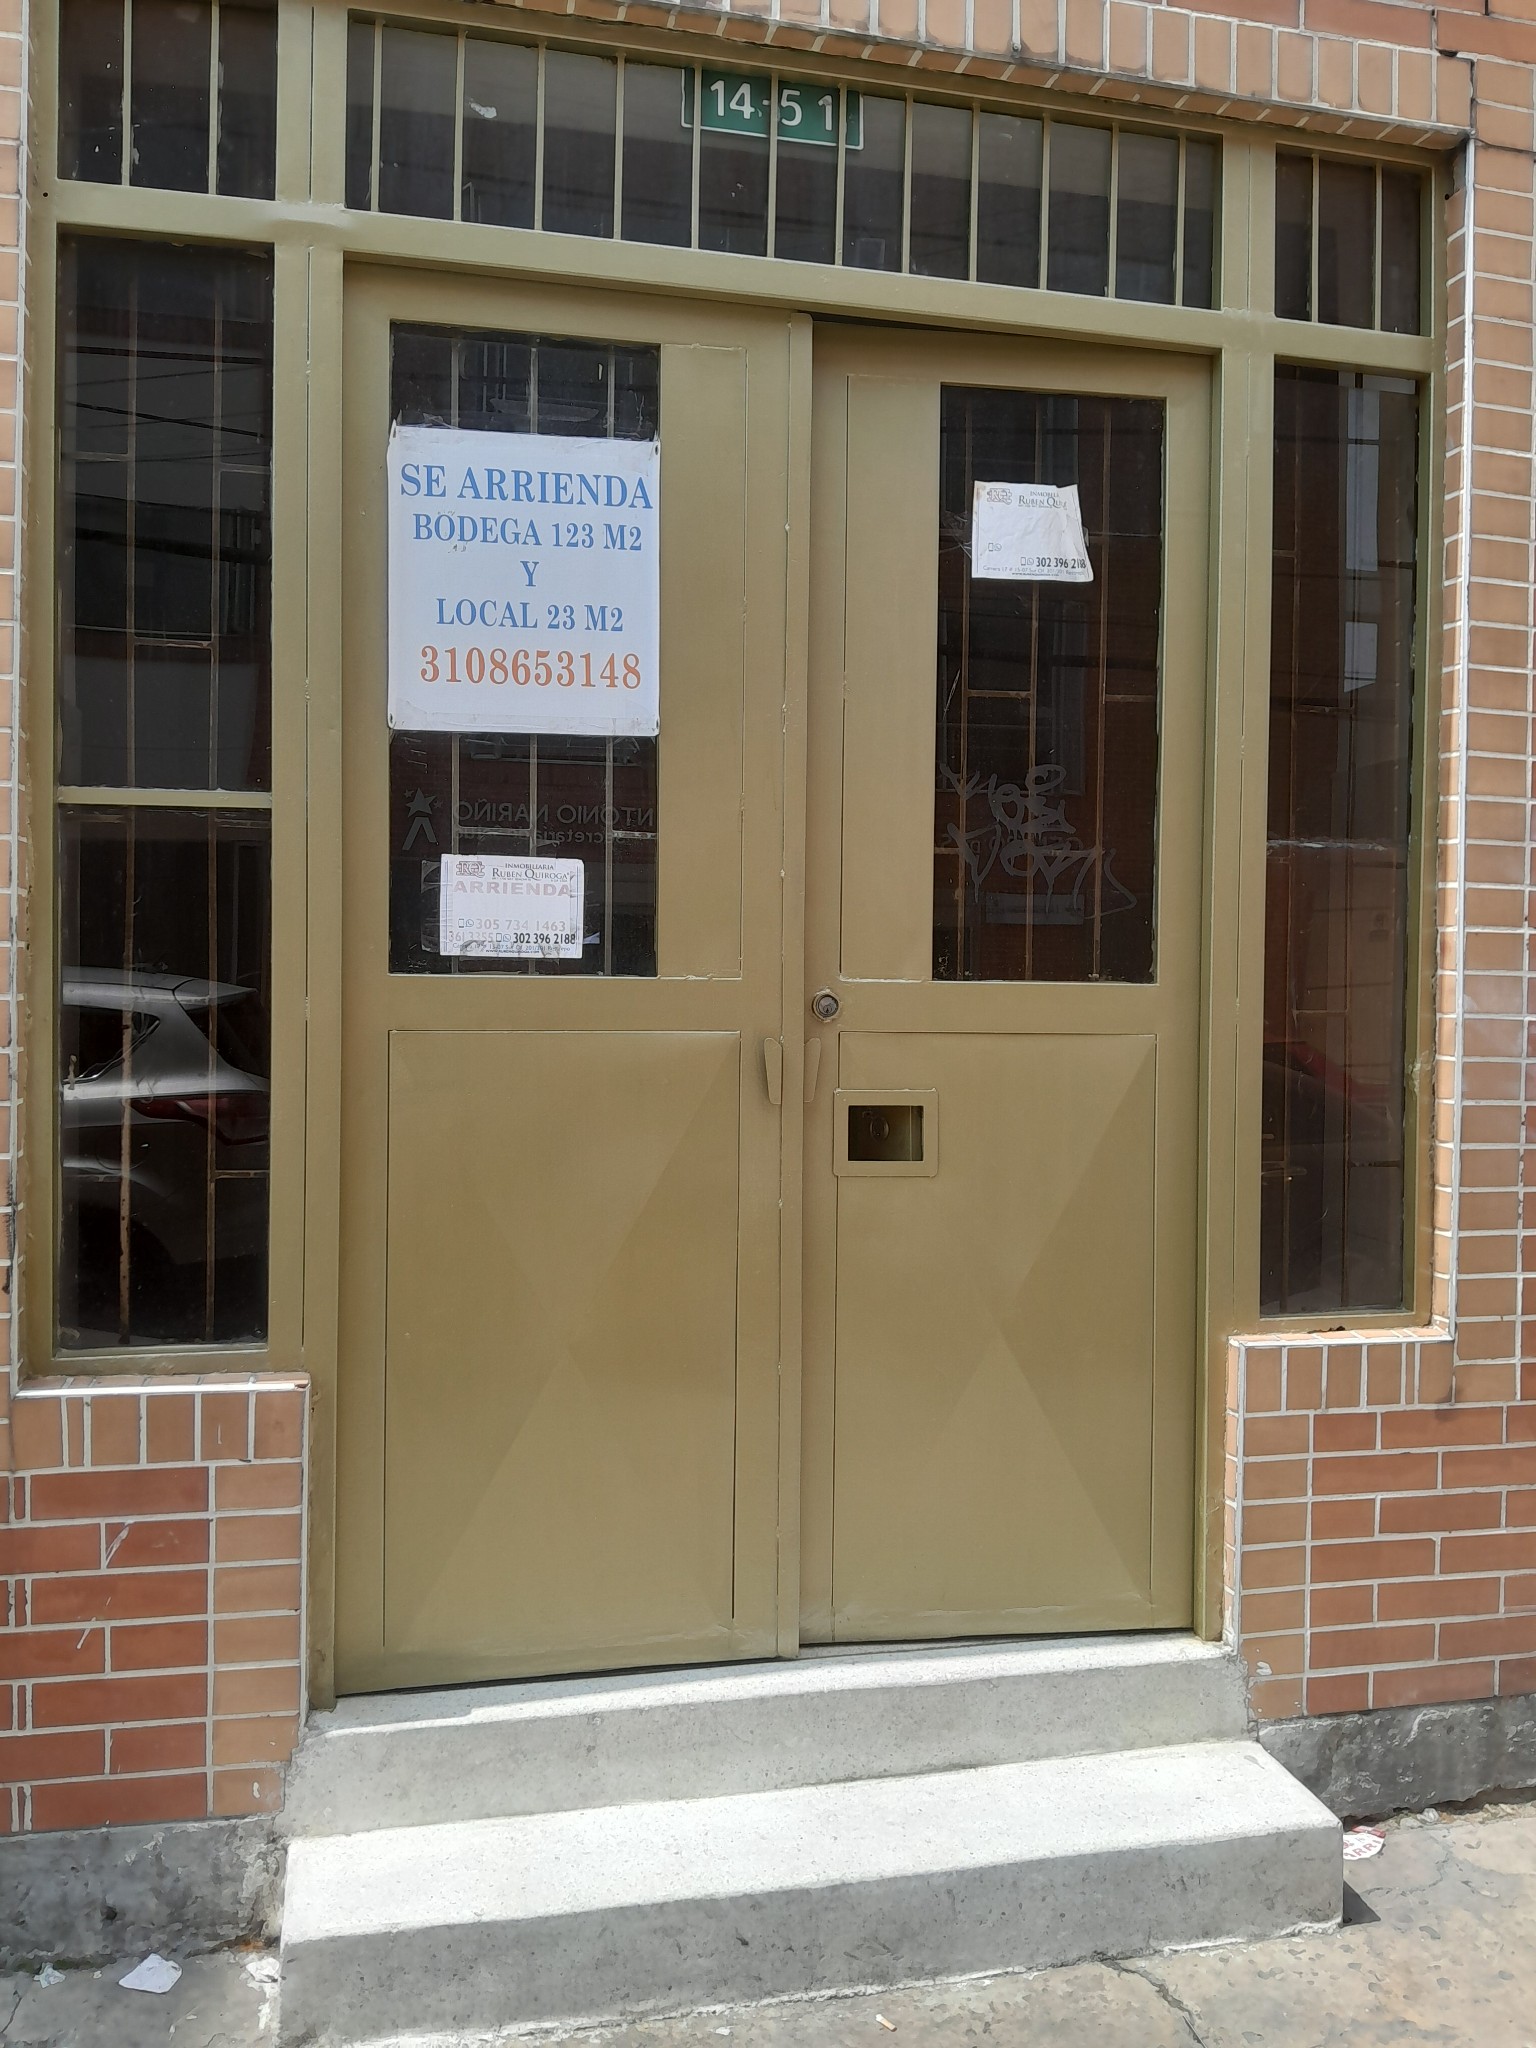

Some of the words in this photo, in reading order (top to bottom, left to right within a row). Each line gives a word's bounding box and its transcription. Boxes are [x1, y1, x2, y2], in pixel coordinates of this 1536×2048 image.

[400, 463, 447, 499] SE
[457, 466, 653, 510] ARRIENDA
[413, 513, 542, 546] BODEGA
[552, 522, 594, 549] 123
[603, 523, 642, 551] M2
[520, 560, 540, 587] Y
[1036, 556, 1051, 568] 302
[1054, 557, 1069, 569] 396
[436, 598, 538, 629] LOCAL
[547, 604, 576, 631] 23
[584, 604, 624, 632] M2
[420, 645, 642, 690] 3108653148
[453, 880, 571, 897] ARRIENDA
[476, 919, 500, 931] 305
[505, 919, 529, 931] 734
[535, 920, 566, 933] 1463
[513, 932, 531, 944] 302
[533, 932, 551, 945] 396
[554, 933, 576, 945] 2188
